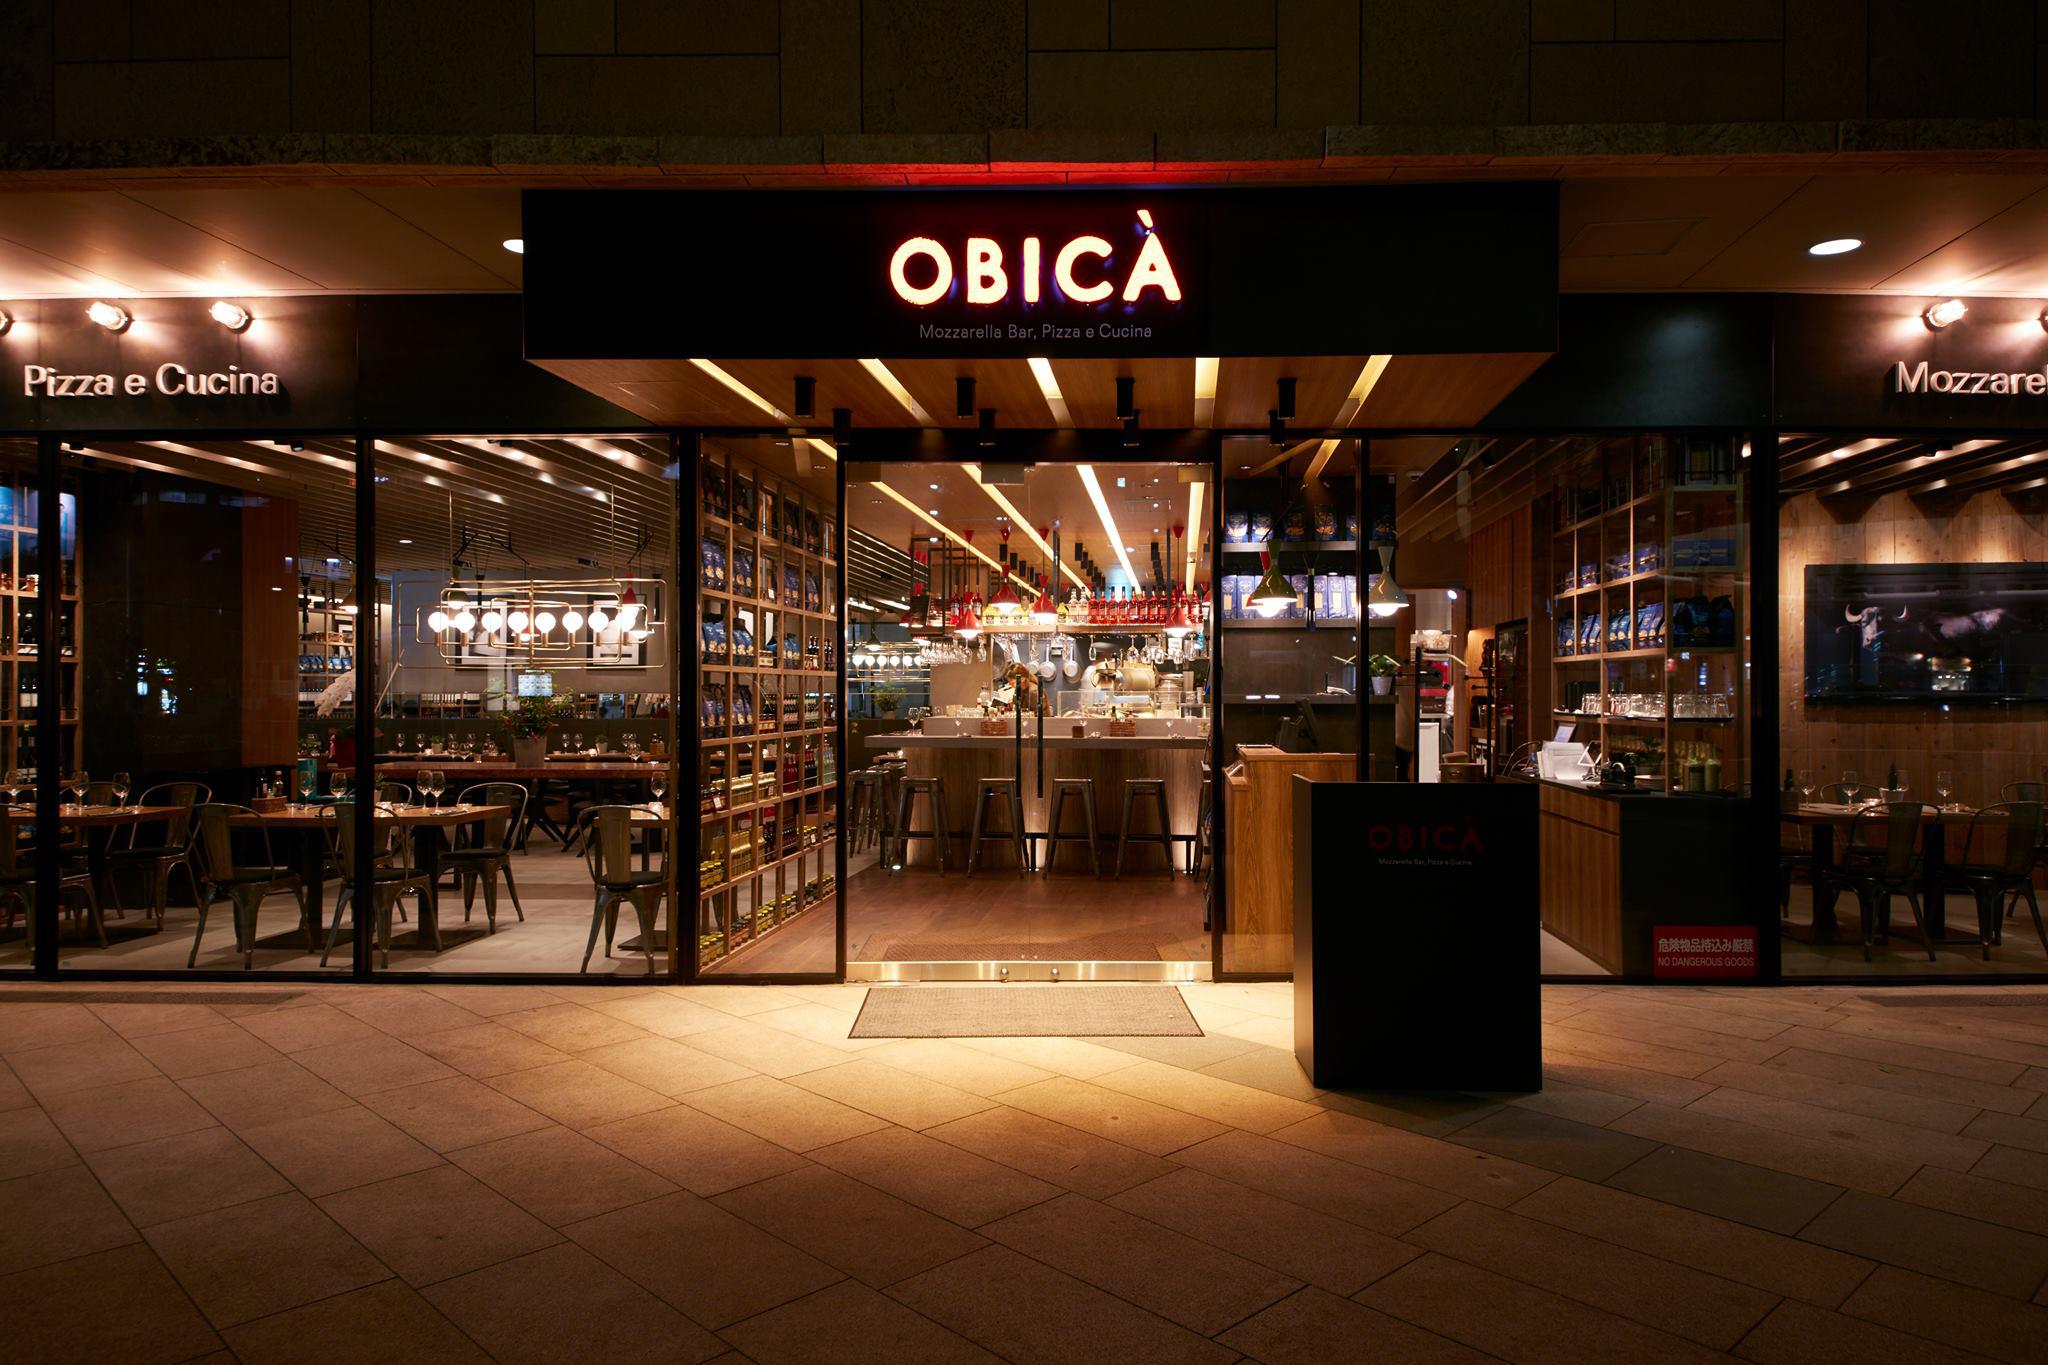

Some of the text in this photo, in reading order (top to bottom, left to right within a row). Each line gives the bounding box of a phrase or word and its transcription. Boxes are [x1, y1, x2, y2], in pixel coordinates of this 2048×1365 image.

[889, 209, 1182, 305] OBICÀ
[919, 323, 1152, 340] Mozzarella Bar, Pizza e Cucina
[24, 362, 281, 396] Pizza e Cucina
[1895, 360, 2048, 395] Mozzare
[1367, 816, 1486, 852] OBICÀ
[1658, 957, 1755, 967] NO DANGEROUS GOODS
